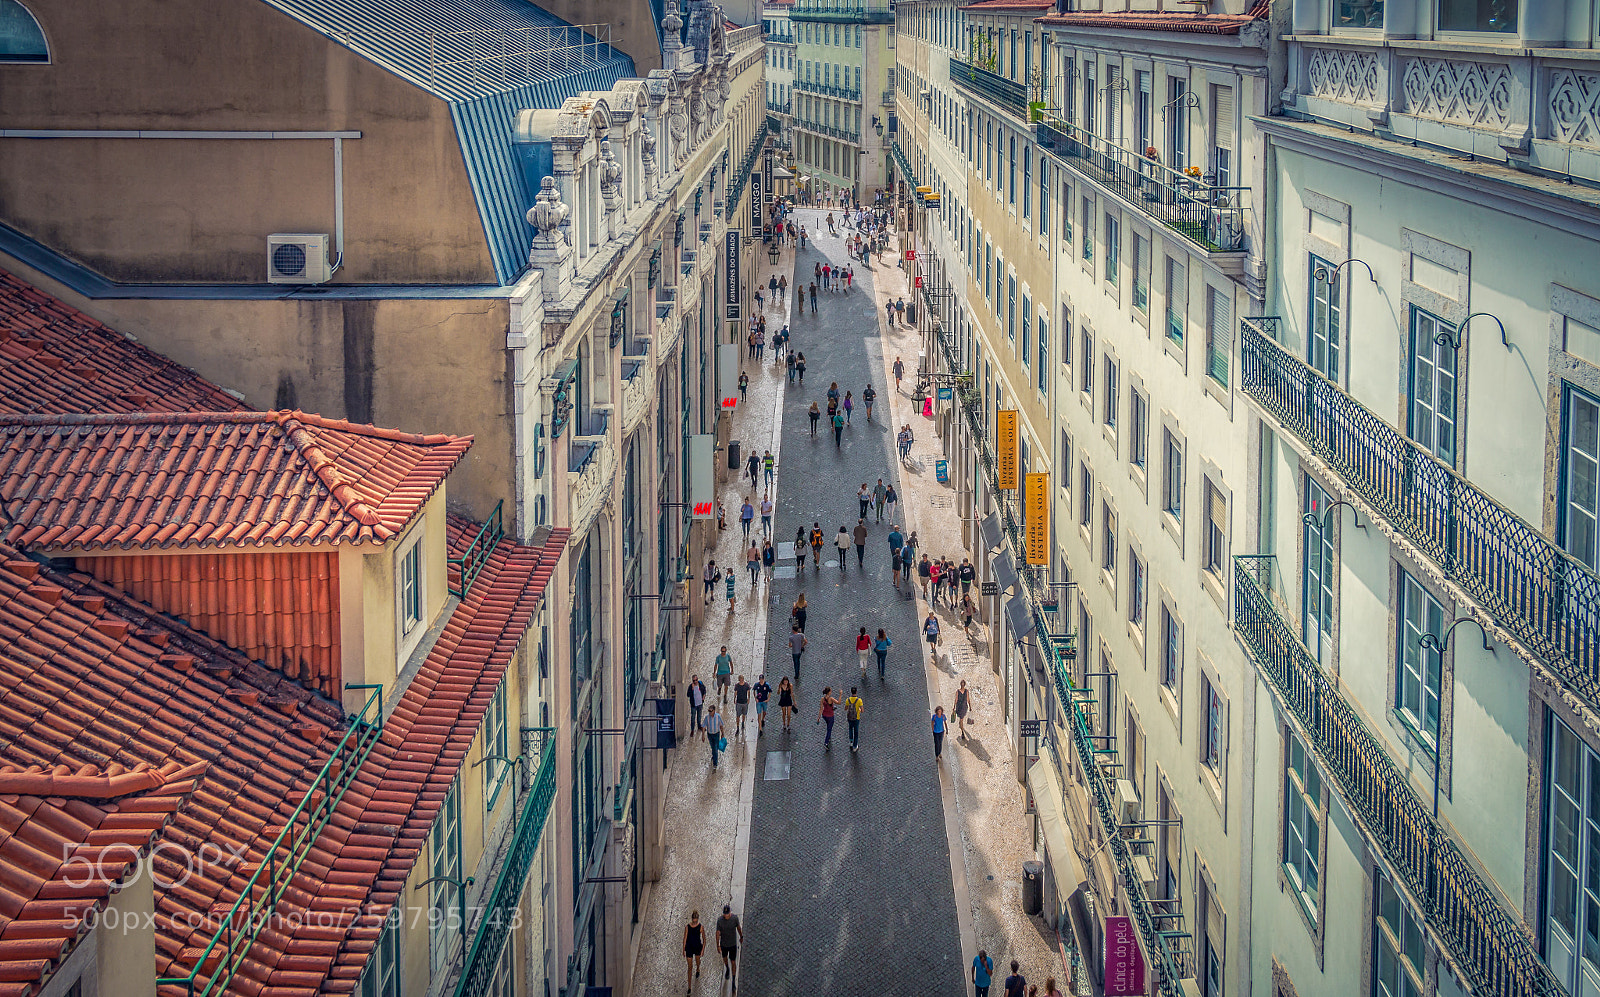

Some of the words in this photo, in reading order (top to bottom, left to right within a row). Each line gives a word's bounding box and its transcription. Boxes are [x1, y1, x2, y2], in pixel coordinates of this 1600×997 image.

[730, 258, 736, 268] DO
[728, 268, 736, 303] ARMAZÉNS
[1113, 945, 1127, 958] do
